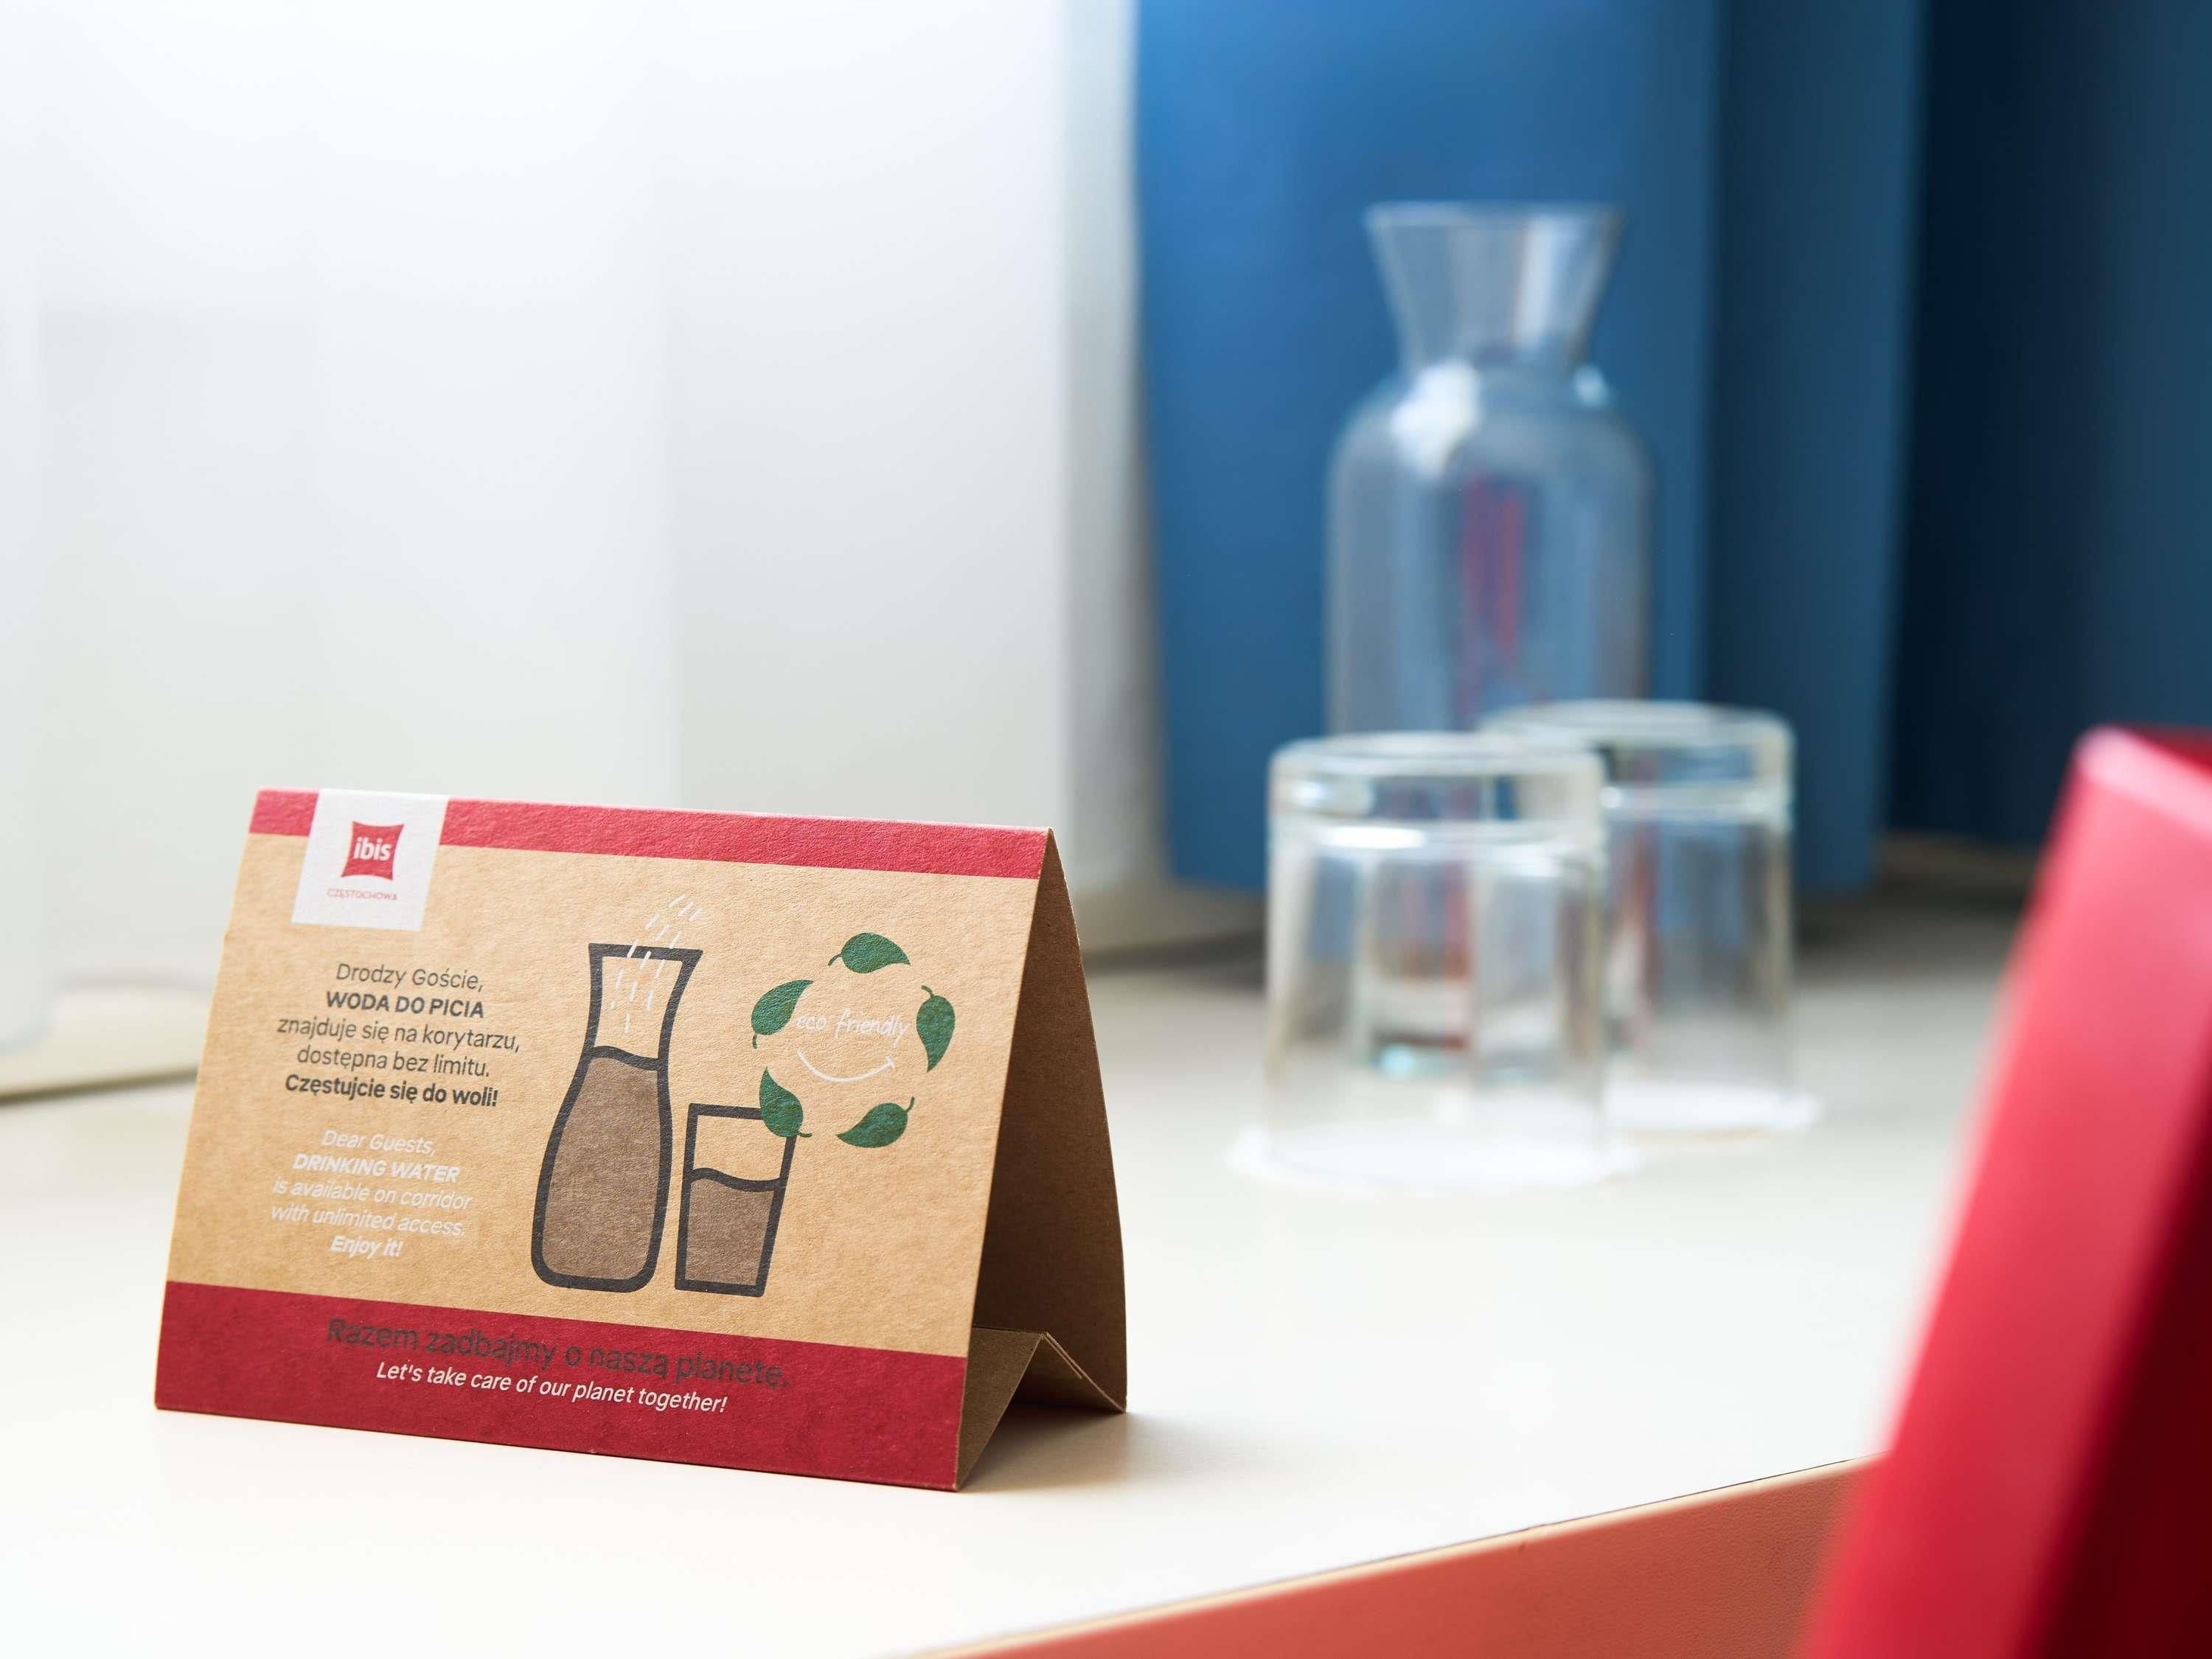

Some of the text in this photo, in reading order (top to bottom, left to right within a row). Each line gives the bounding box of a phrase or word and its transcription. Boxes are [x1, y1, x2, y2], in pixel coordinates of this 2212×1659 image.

[353, 838, 393, 861] ibis
[336, 963, 483, 992] Drodzy Goście,
[327, 991, 484, 1018] WODA DO PICIA
[277, 1017, 520, 1053] znajduje się na korytarzu,
[796, 1007, 909, 1048] eco friendly
[297, 1045, 489, 1077] dostępna bez limitu.
[285, 1074, 498, 1107] Częstujcie się do woli!
[321, 1129, 435, 1156] Dear Guests,
[293, 1153, 460, 1183] DRINKING WATER
[272, 1177, 473, 1210] is available on corridor
[271, 1203, 465, 1237] with unlimited access.
[330, 1235, 404, 1259] Enjoy it!
[328, 1318, 789, 1389] Razem zadbajmy o naszą planetę.
[376, 1362, 728, 1412] Let's take care of our planet together!
